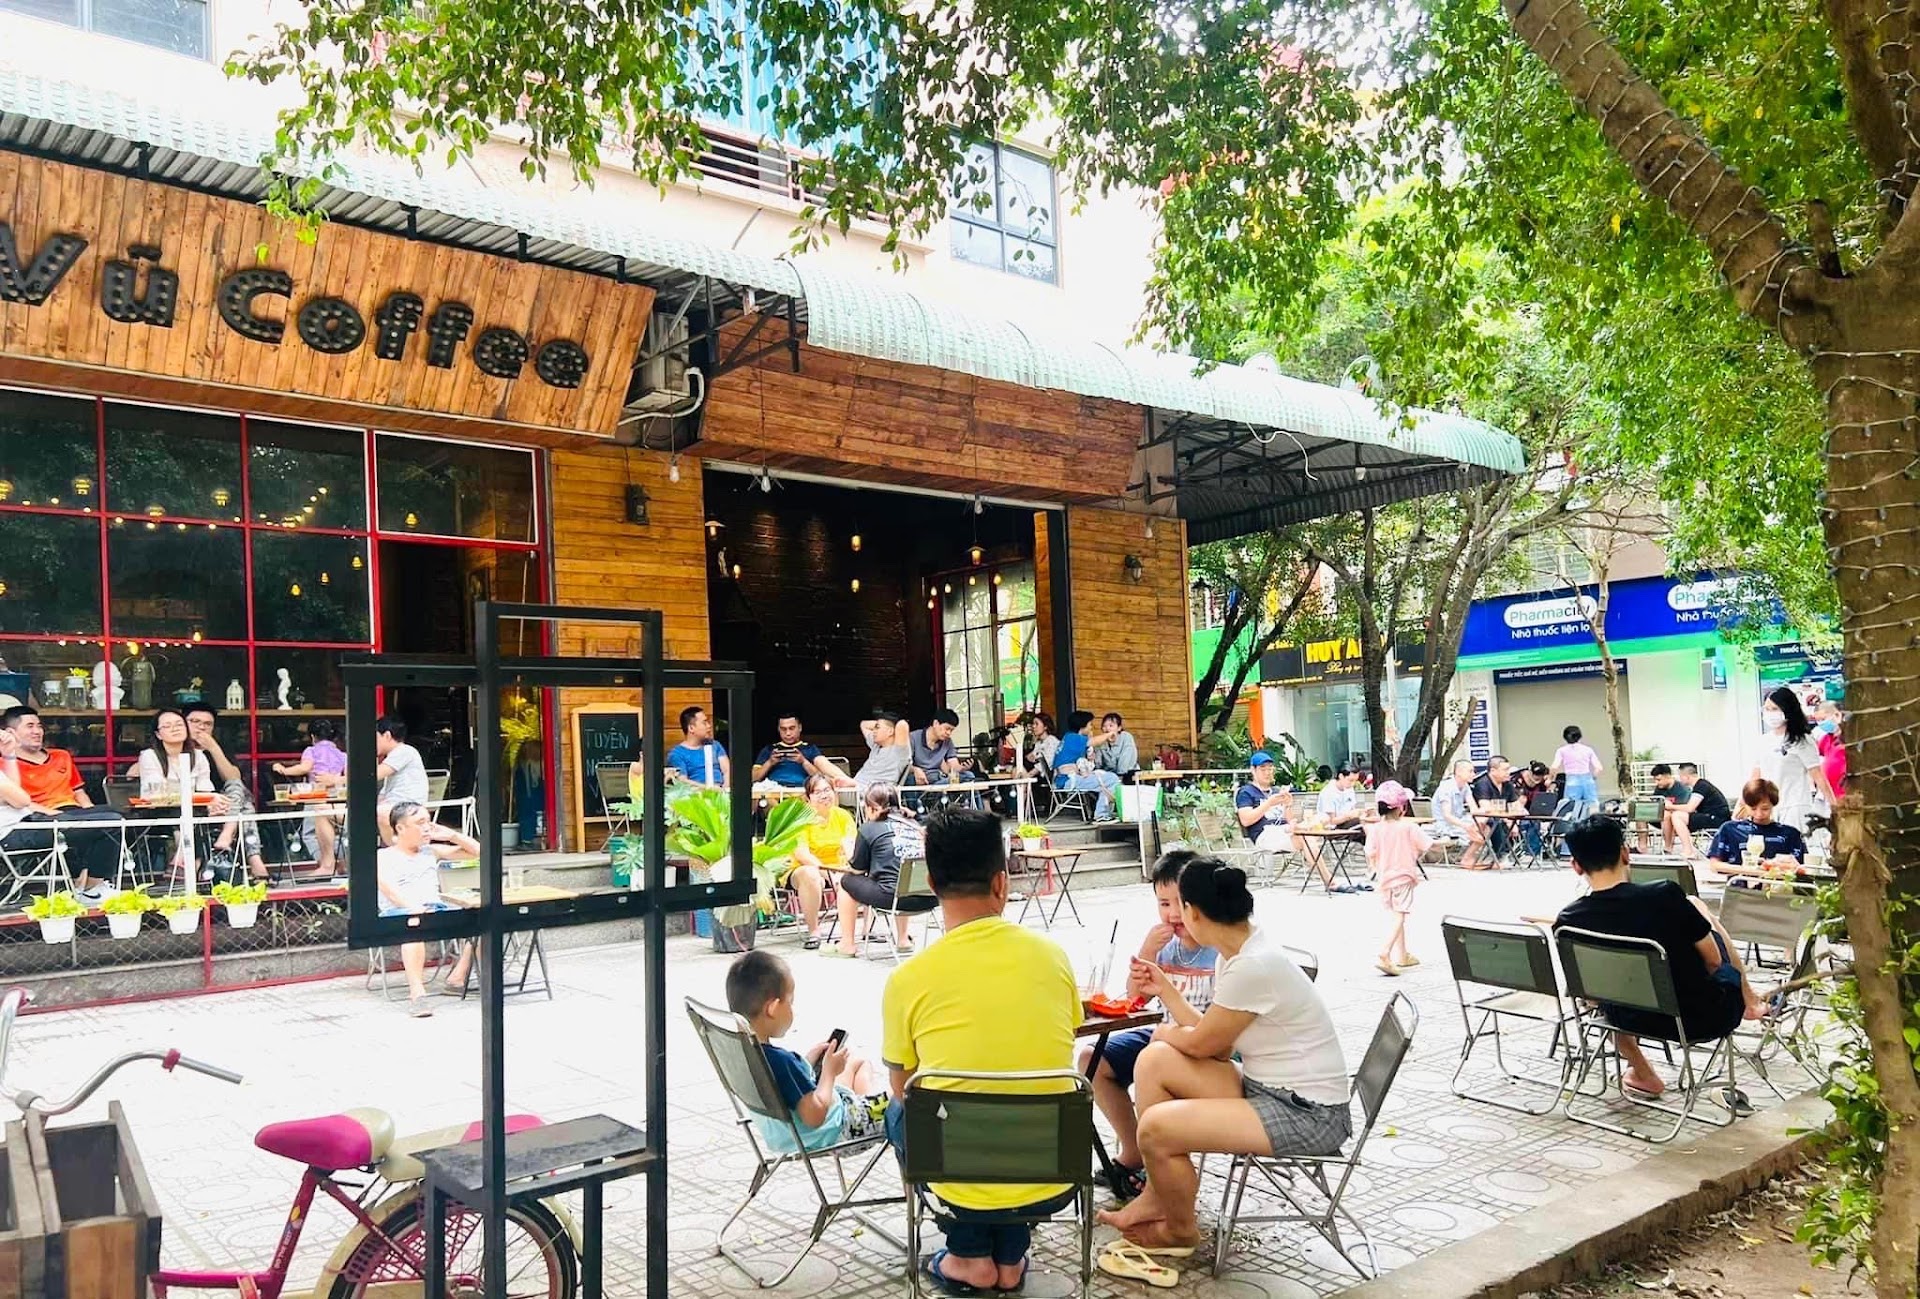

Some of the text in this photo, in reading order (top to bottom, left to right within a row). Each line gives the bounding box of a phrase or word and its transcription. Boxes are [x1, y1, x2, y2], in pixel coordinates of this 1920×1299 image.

[0, 221, 591, 390] Vũ Coffee
[1305, 639, 1342, 664] HUY
